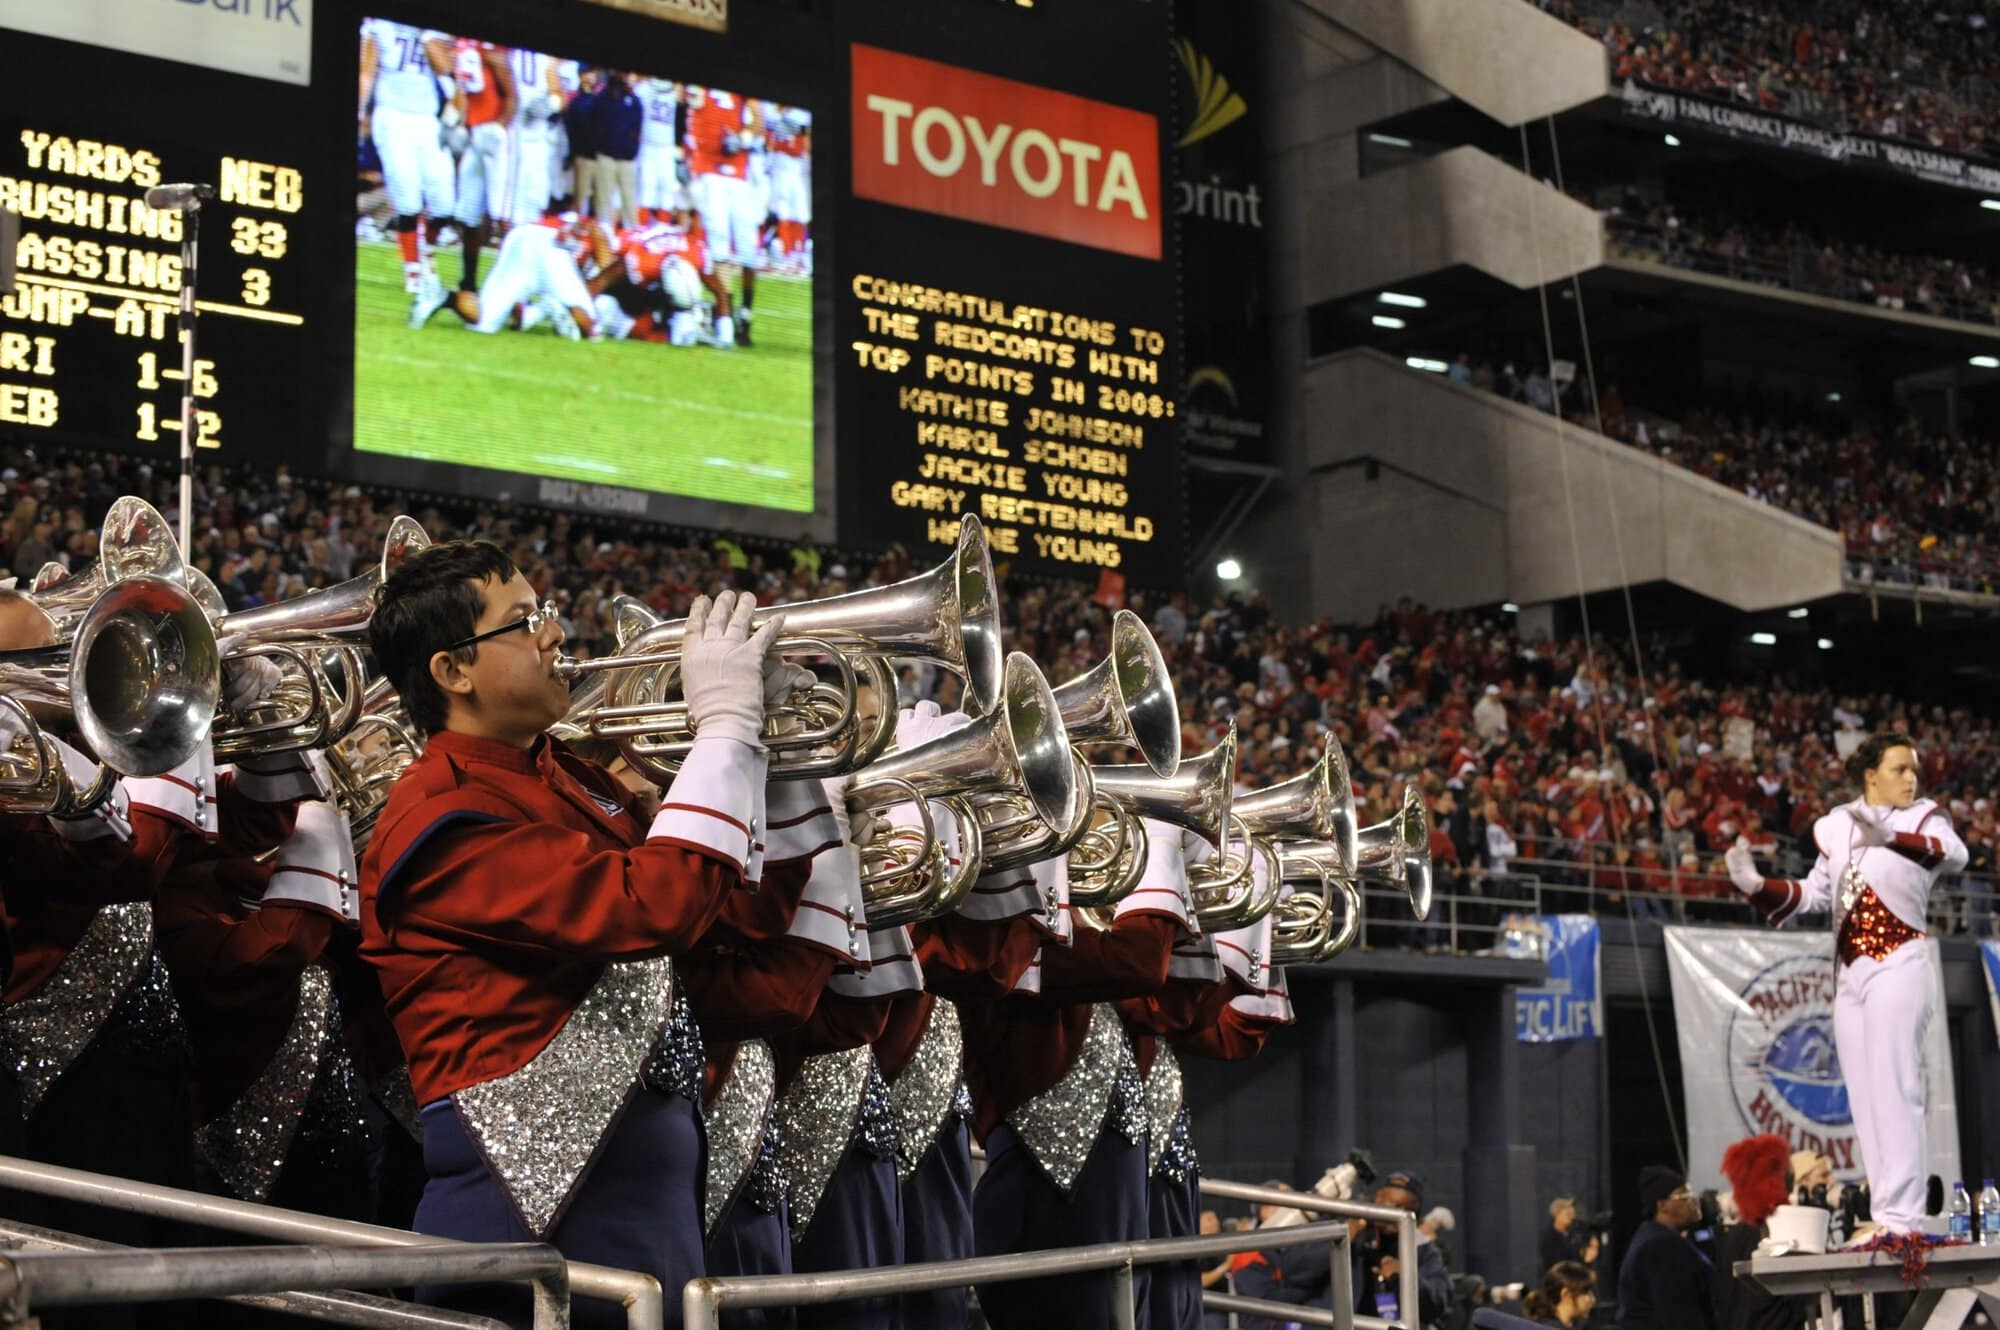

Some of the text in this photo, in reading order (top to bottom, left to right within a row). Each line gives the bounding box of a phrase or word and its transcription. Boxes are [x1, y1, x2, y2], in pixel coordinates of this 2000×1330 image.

[20, 129, 303, 213] YARDS NEB
[866, 94, 1148, 221] TOYOTA
[16, 232, 272, 306] ASSING 3
[230, 216, 288, 260] 33
[853, 273, 1165, 356] CONGRATULATIONS TO
[862, 306, 1158, 384] THE REDCOATS WITH
[852, 341, 1175, 418] TOP POINTS IN 2008:
[136, 402, 222, 449] 1-2
[899, 385, 1010, 427] KATHIE
[1024, 407, 1144, 449] JOHNSON
[917, 420, 1128, 477] KAROL SCHOEN
[891, 480, 966, 514] GARY
[918, 453, 1129, 507] JACKIE YOUNG
[1033, 533, 1122, 568] YOUNG
[1749, 1088, 1855, 1169] HOLIDAY
